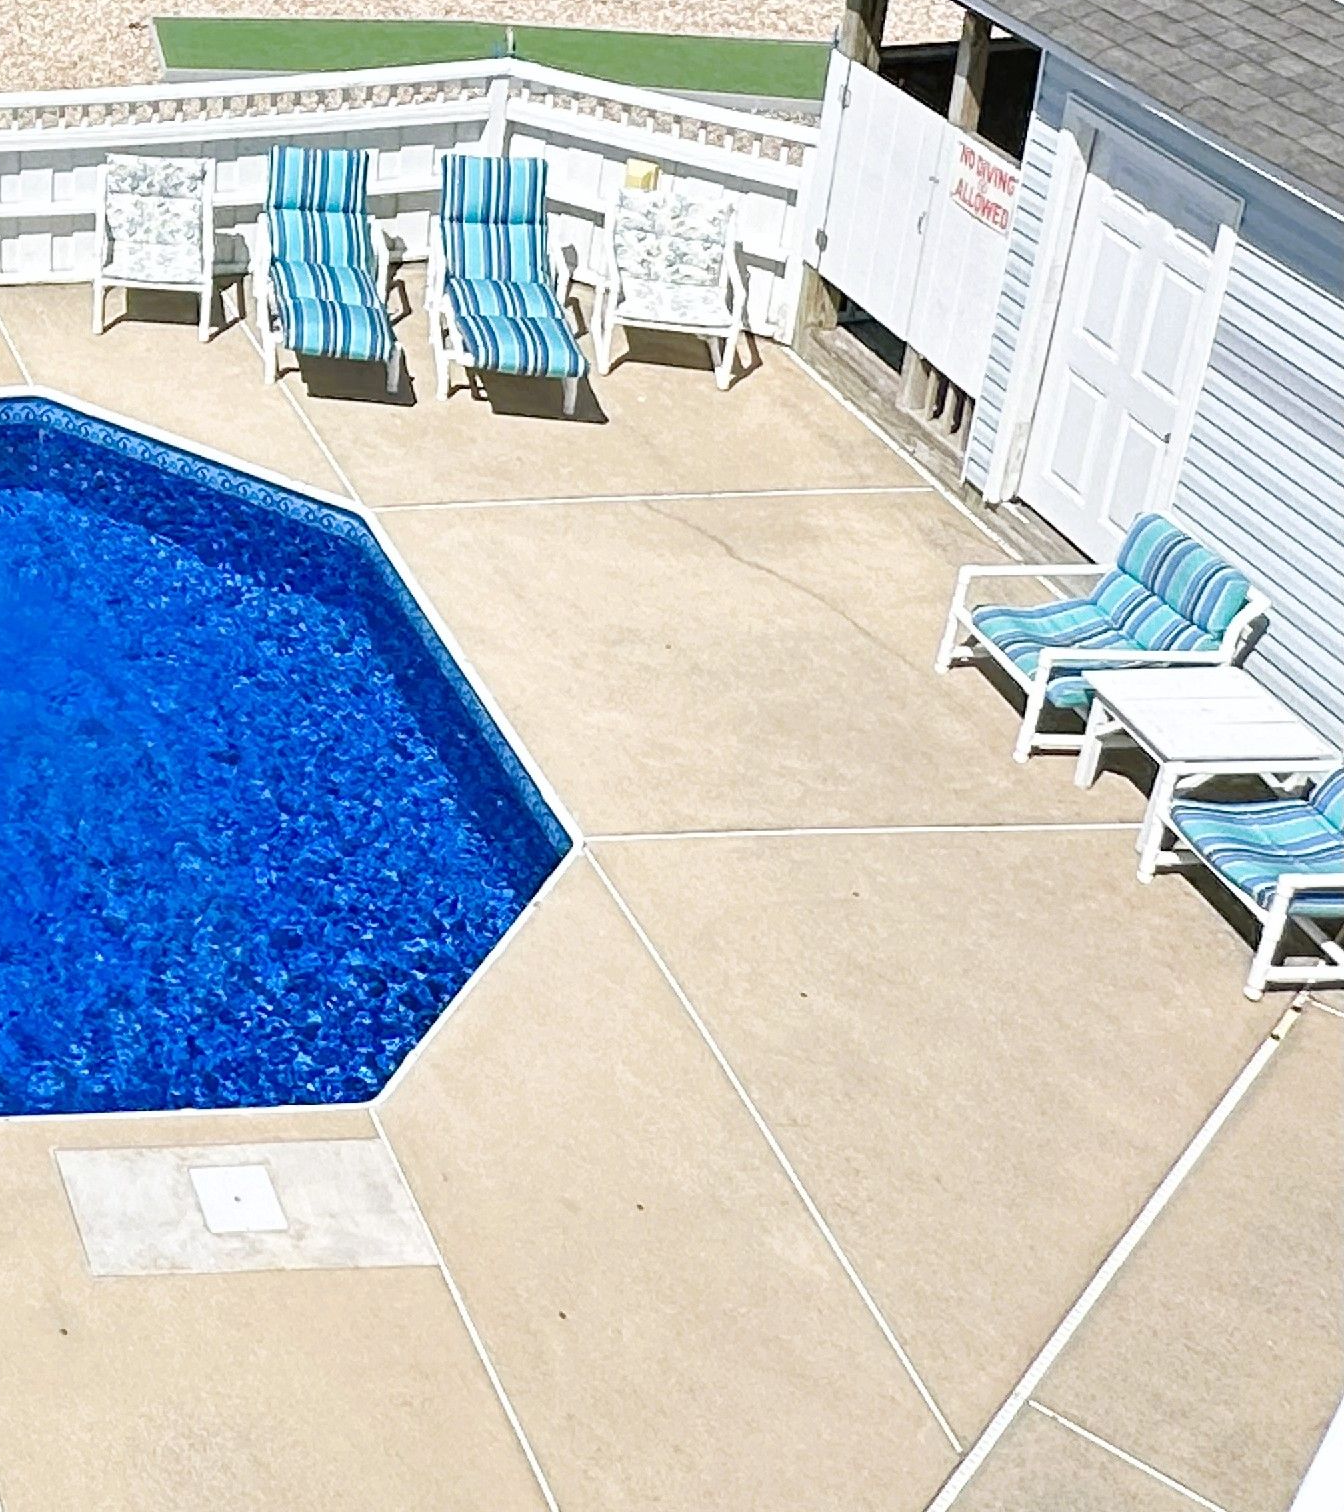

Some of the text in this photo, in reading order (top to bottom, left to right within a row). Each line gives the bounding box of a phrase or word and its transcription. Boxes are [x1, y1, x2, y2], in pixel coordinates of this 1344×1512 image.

[960, 143, 976, 170] NO
[976, 158, 1017, 196] DIVING
[955, 178, 1009, 229] ALLOWED
